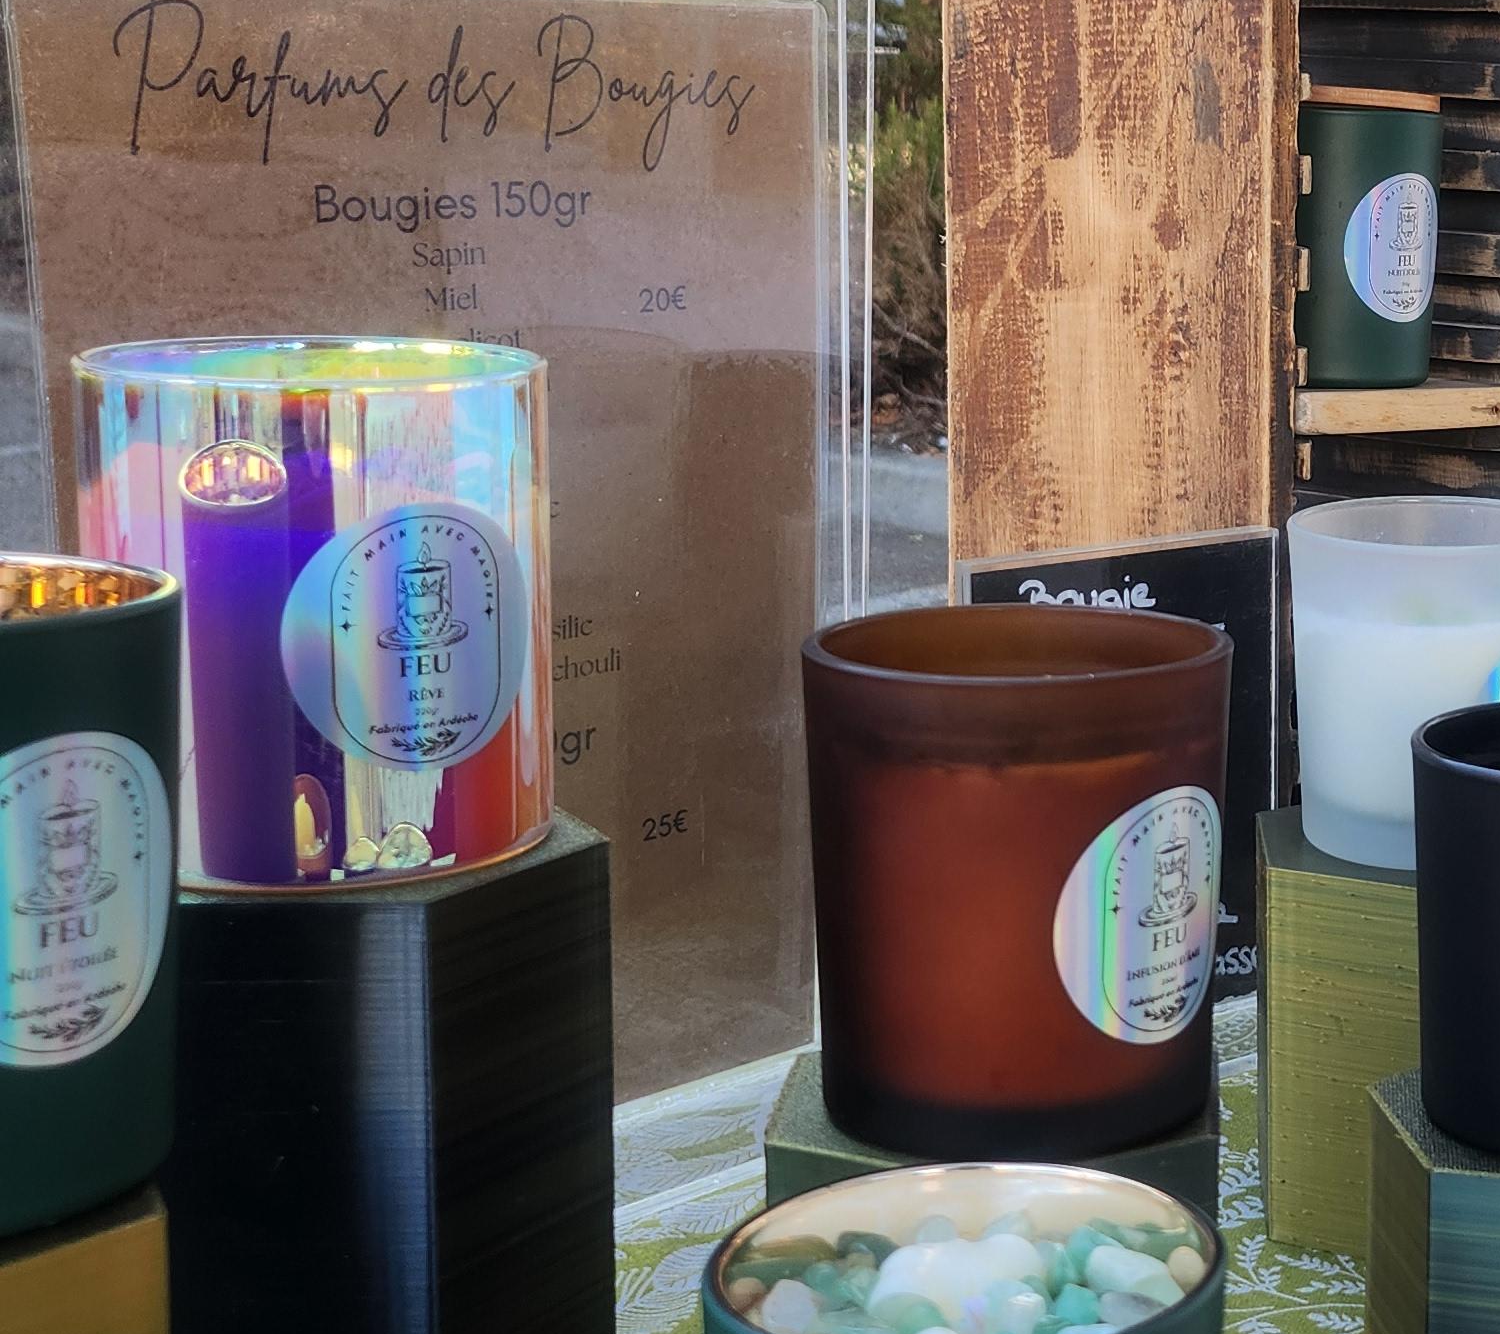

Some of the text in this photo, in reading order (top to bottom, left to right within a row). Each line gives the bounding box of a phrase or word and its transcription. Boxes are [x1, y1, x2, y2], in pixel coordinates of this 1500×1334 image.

[428, 24, 516, 143] des
[537, 13, 756, 171] Bougies
[314, 180, 592, 233] Bougies 150gr
[412, 242, 486, 275] Sapin
[1398, 254, 1416, 267] FEU
[425, 283, 478, 313] Miel
[639, 285, 687, 314] 20€
[364, 528, 408, 562] MAIN
[421, 524, 466, 543] AVEC
[399, 651, 453, 678] FEU
[552, 648, 622, 682] chouli
[642, 809, 689, 842] 25€
[39, 916, 100, 949] FEU
[1152, 923, 1188, 953] FEU
